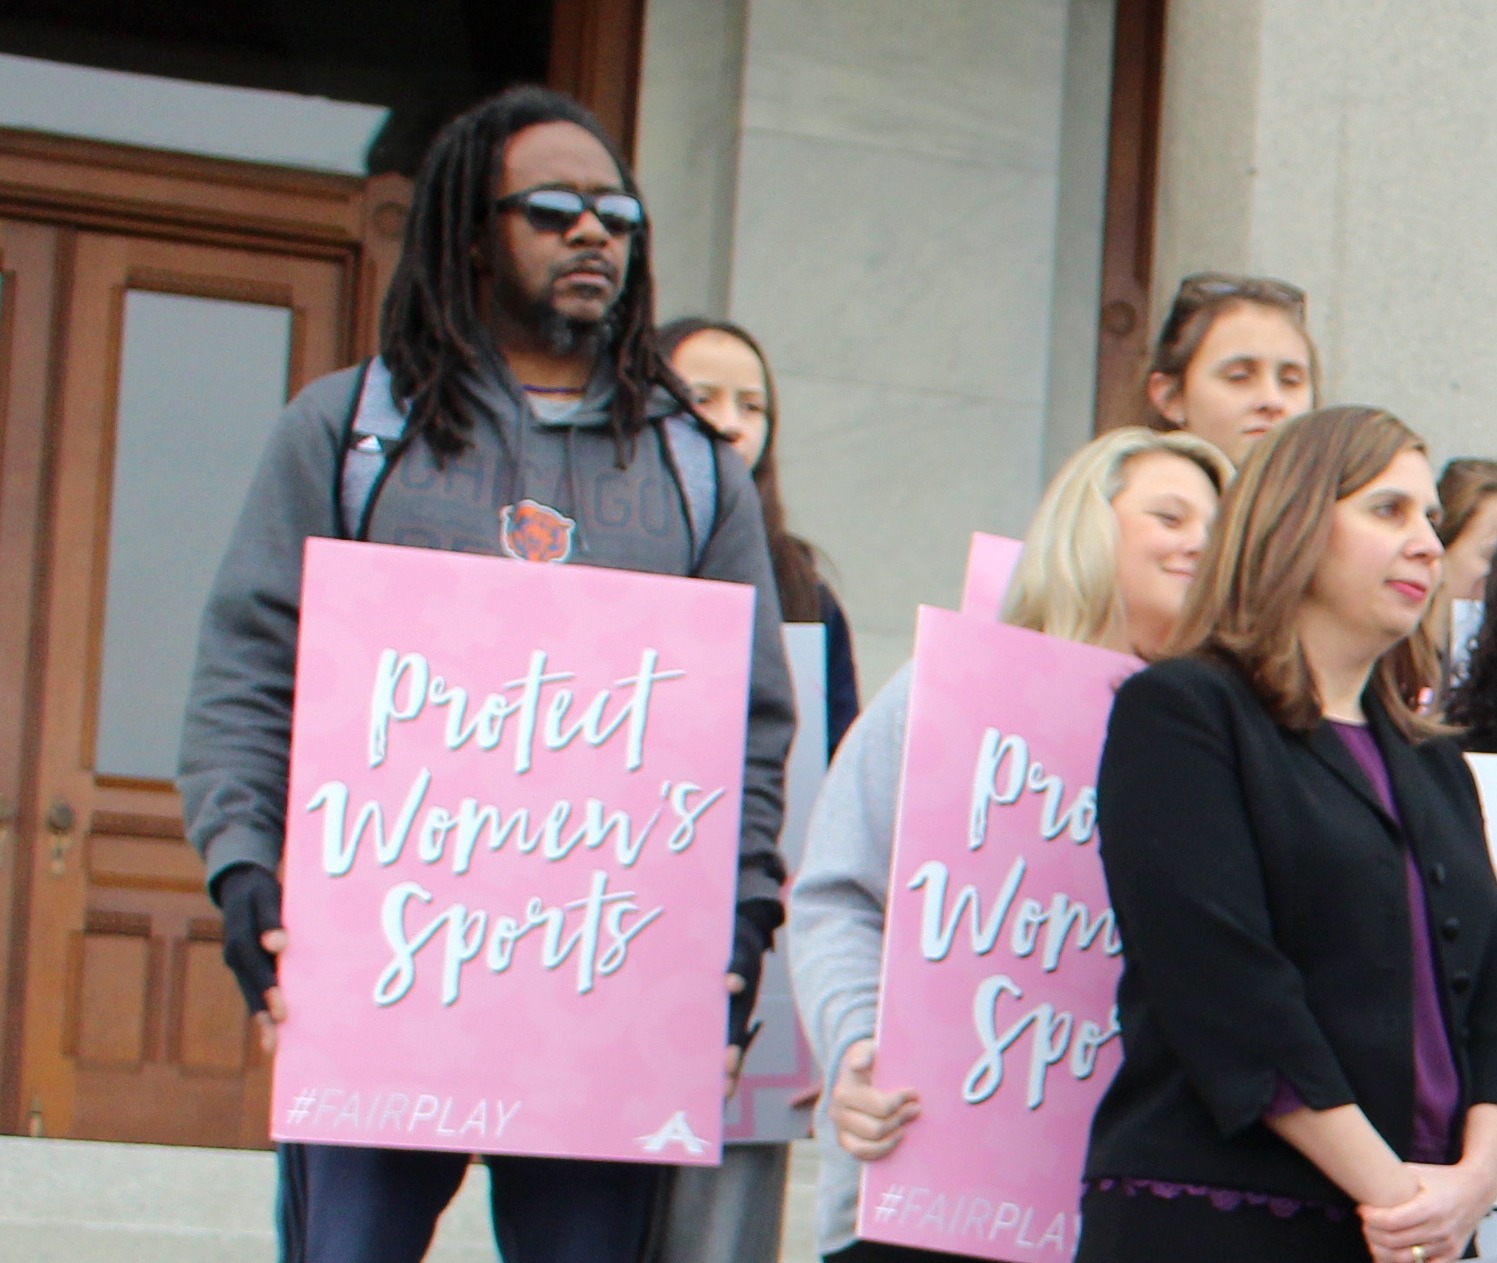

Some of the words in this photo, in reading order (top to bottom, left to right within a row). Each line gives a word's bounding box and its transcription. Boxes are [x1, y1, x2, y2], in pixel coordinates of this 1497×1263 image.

[369, 648, 688, 774] Protect
[306, 767, 727, 878] Women's
[374, 869, 665, 1008] Sports
[286, 1087, 521, 1138] #FAIRPLAY
